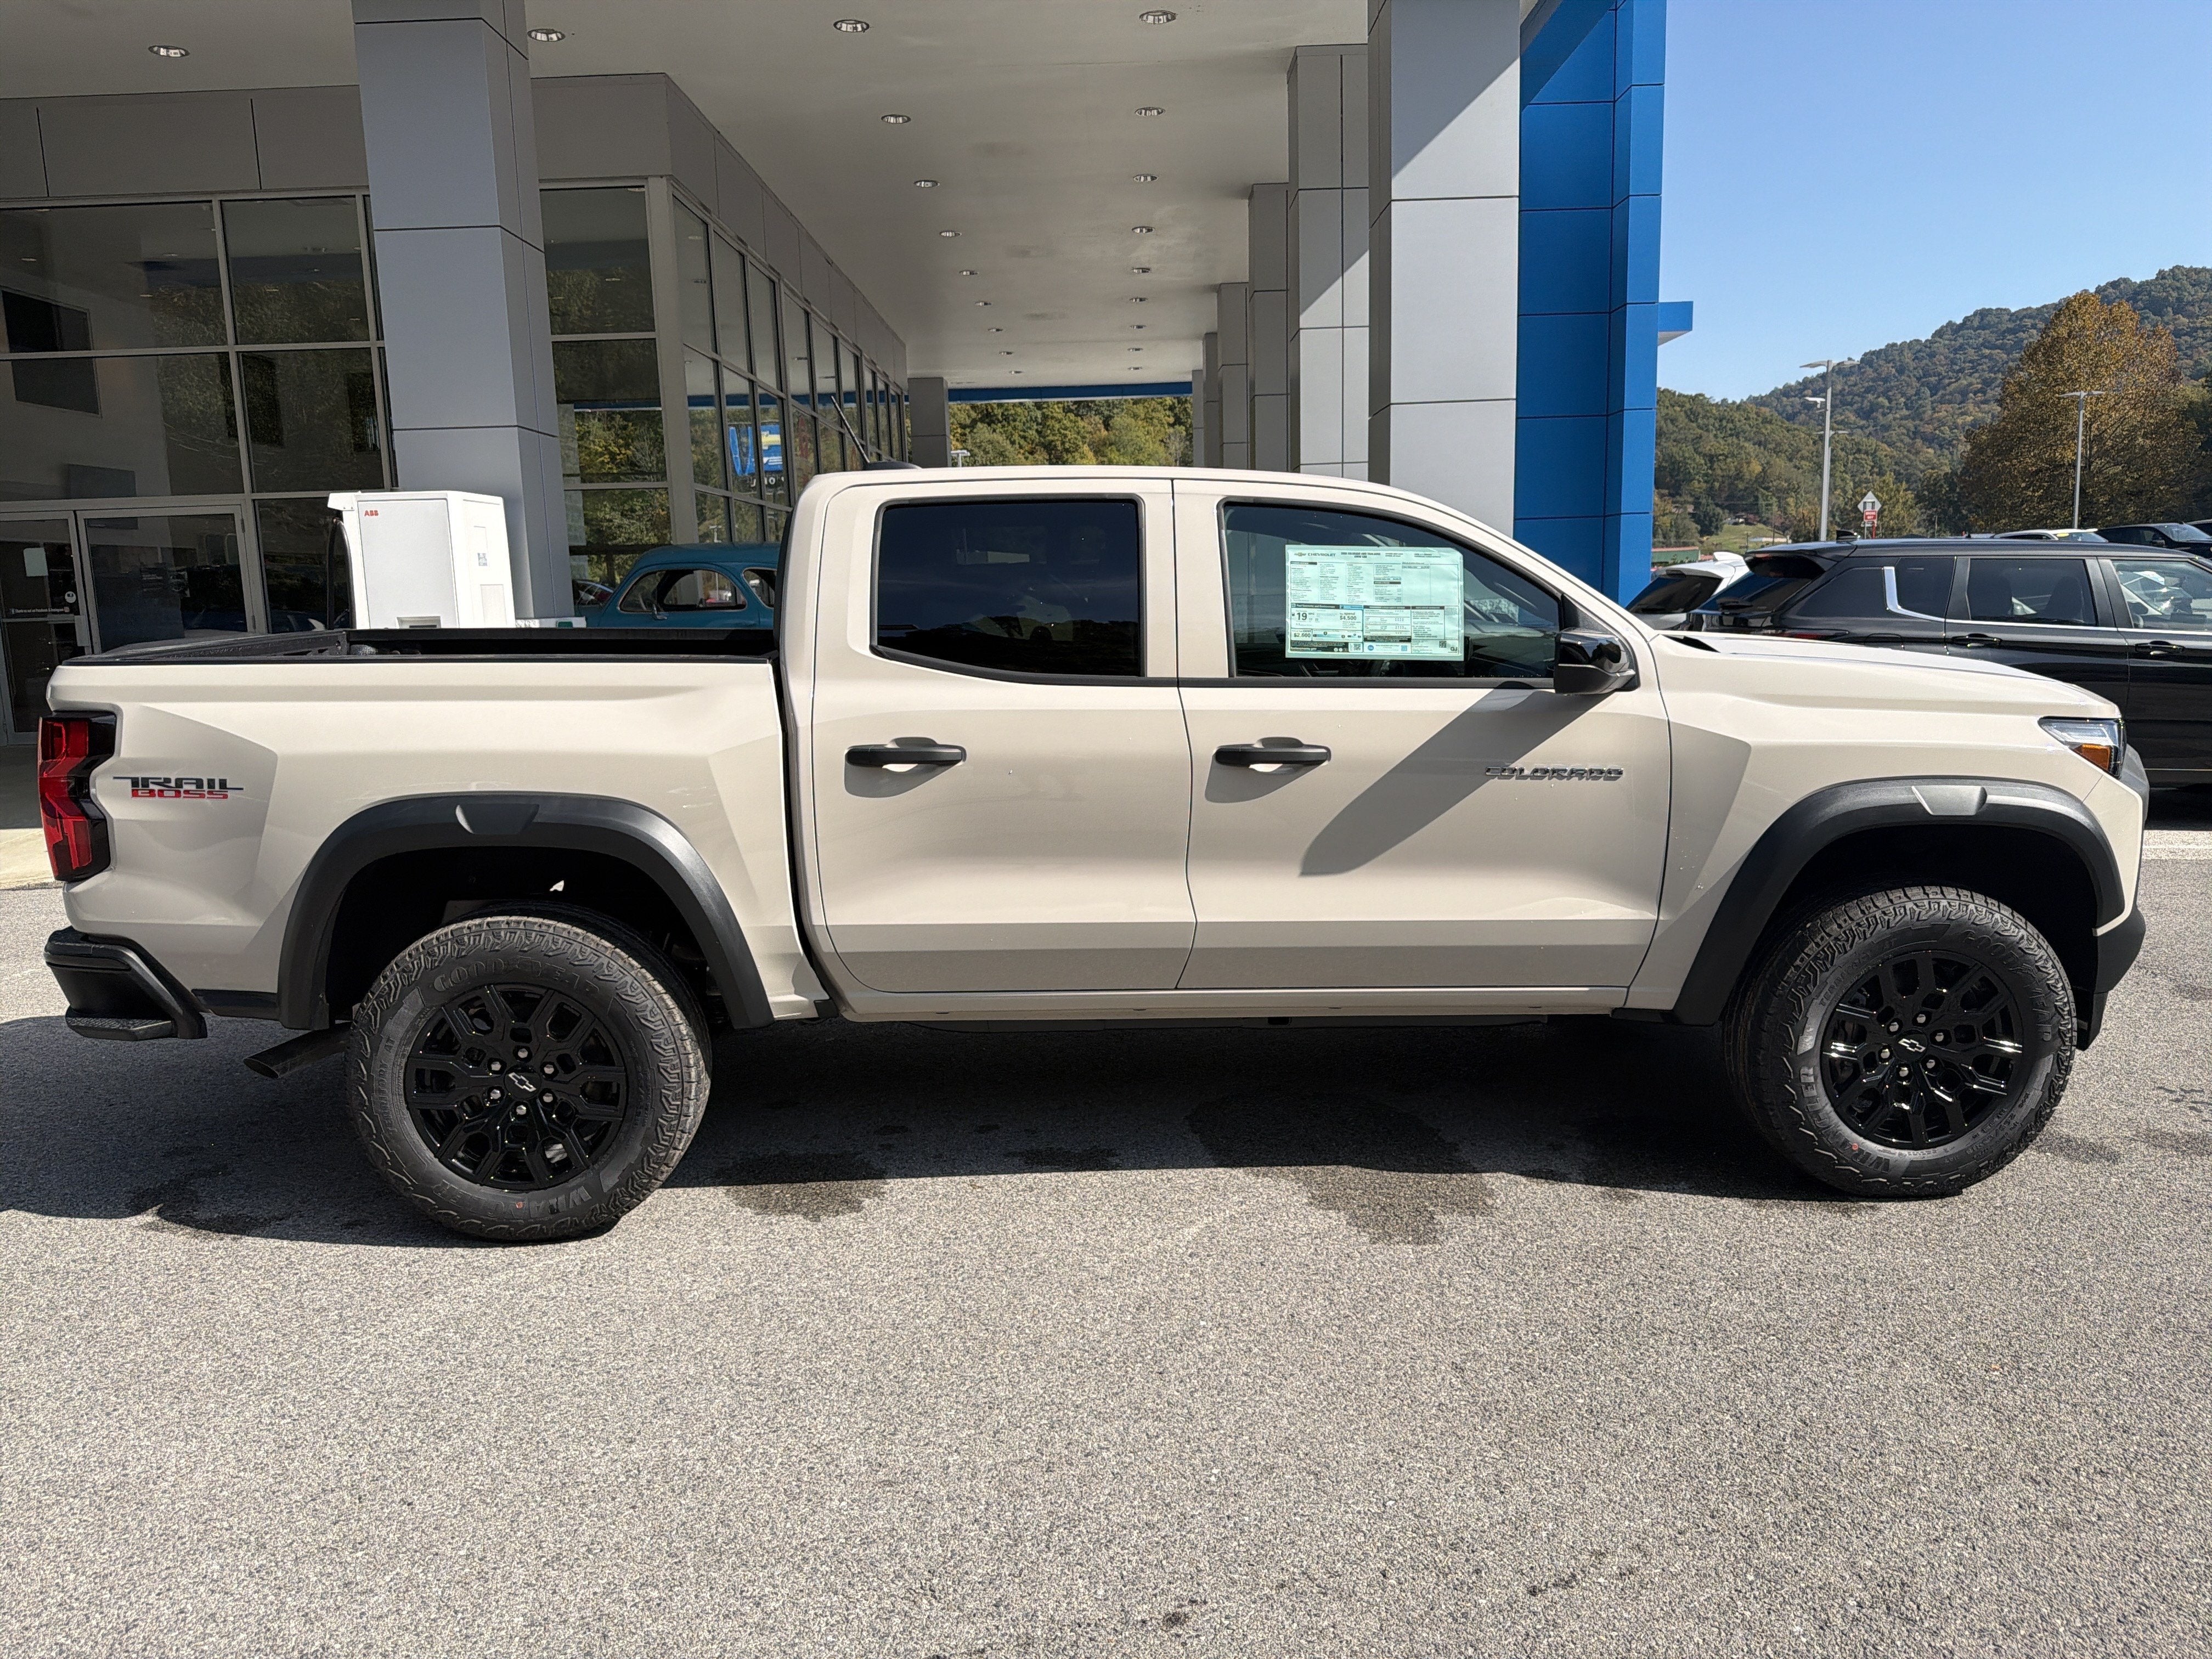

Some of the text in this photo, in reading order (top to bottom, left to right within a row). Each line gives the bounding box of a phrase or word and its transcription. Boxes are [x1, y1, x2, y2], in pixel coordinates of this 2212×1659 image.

[1296, 612, 1307, 620] 19
[1485, 765, 1624, 778] COLORADO
[112, 776, 244, 791] TRAIL
[131, 788, 229, 800] BOSS
[432, 955, 601, 996] GOODYEAR
[1799, 1065, 1891, 1173] WRANGLER
[431, 1177, 592, 1219] WRANGLER
